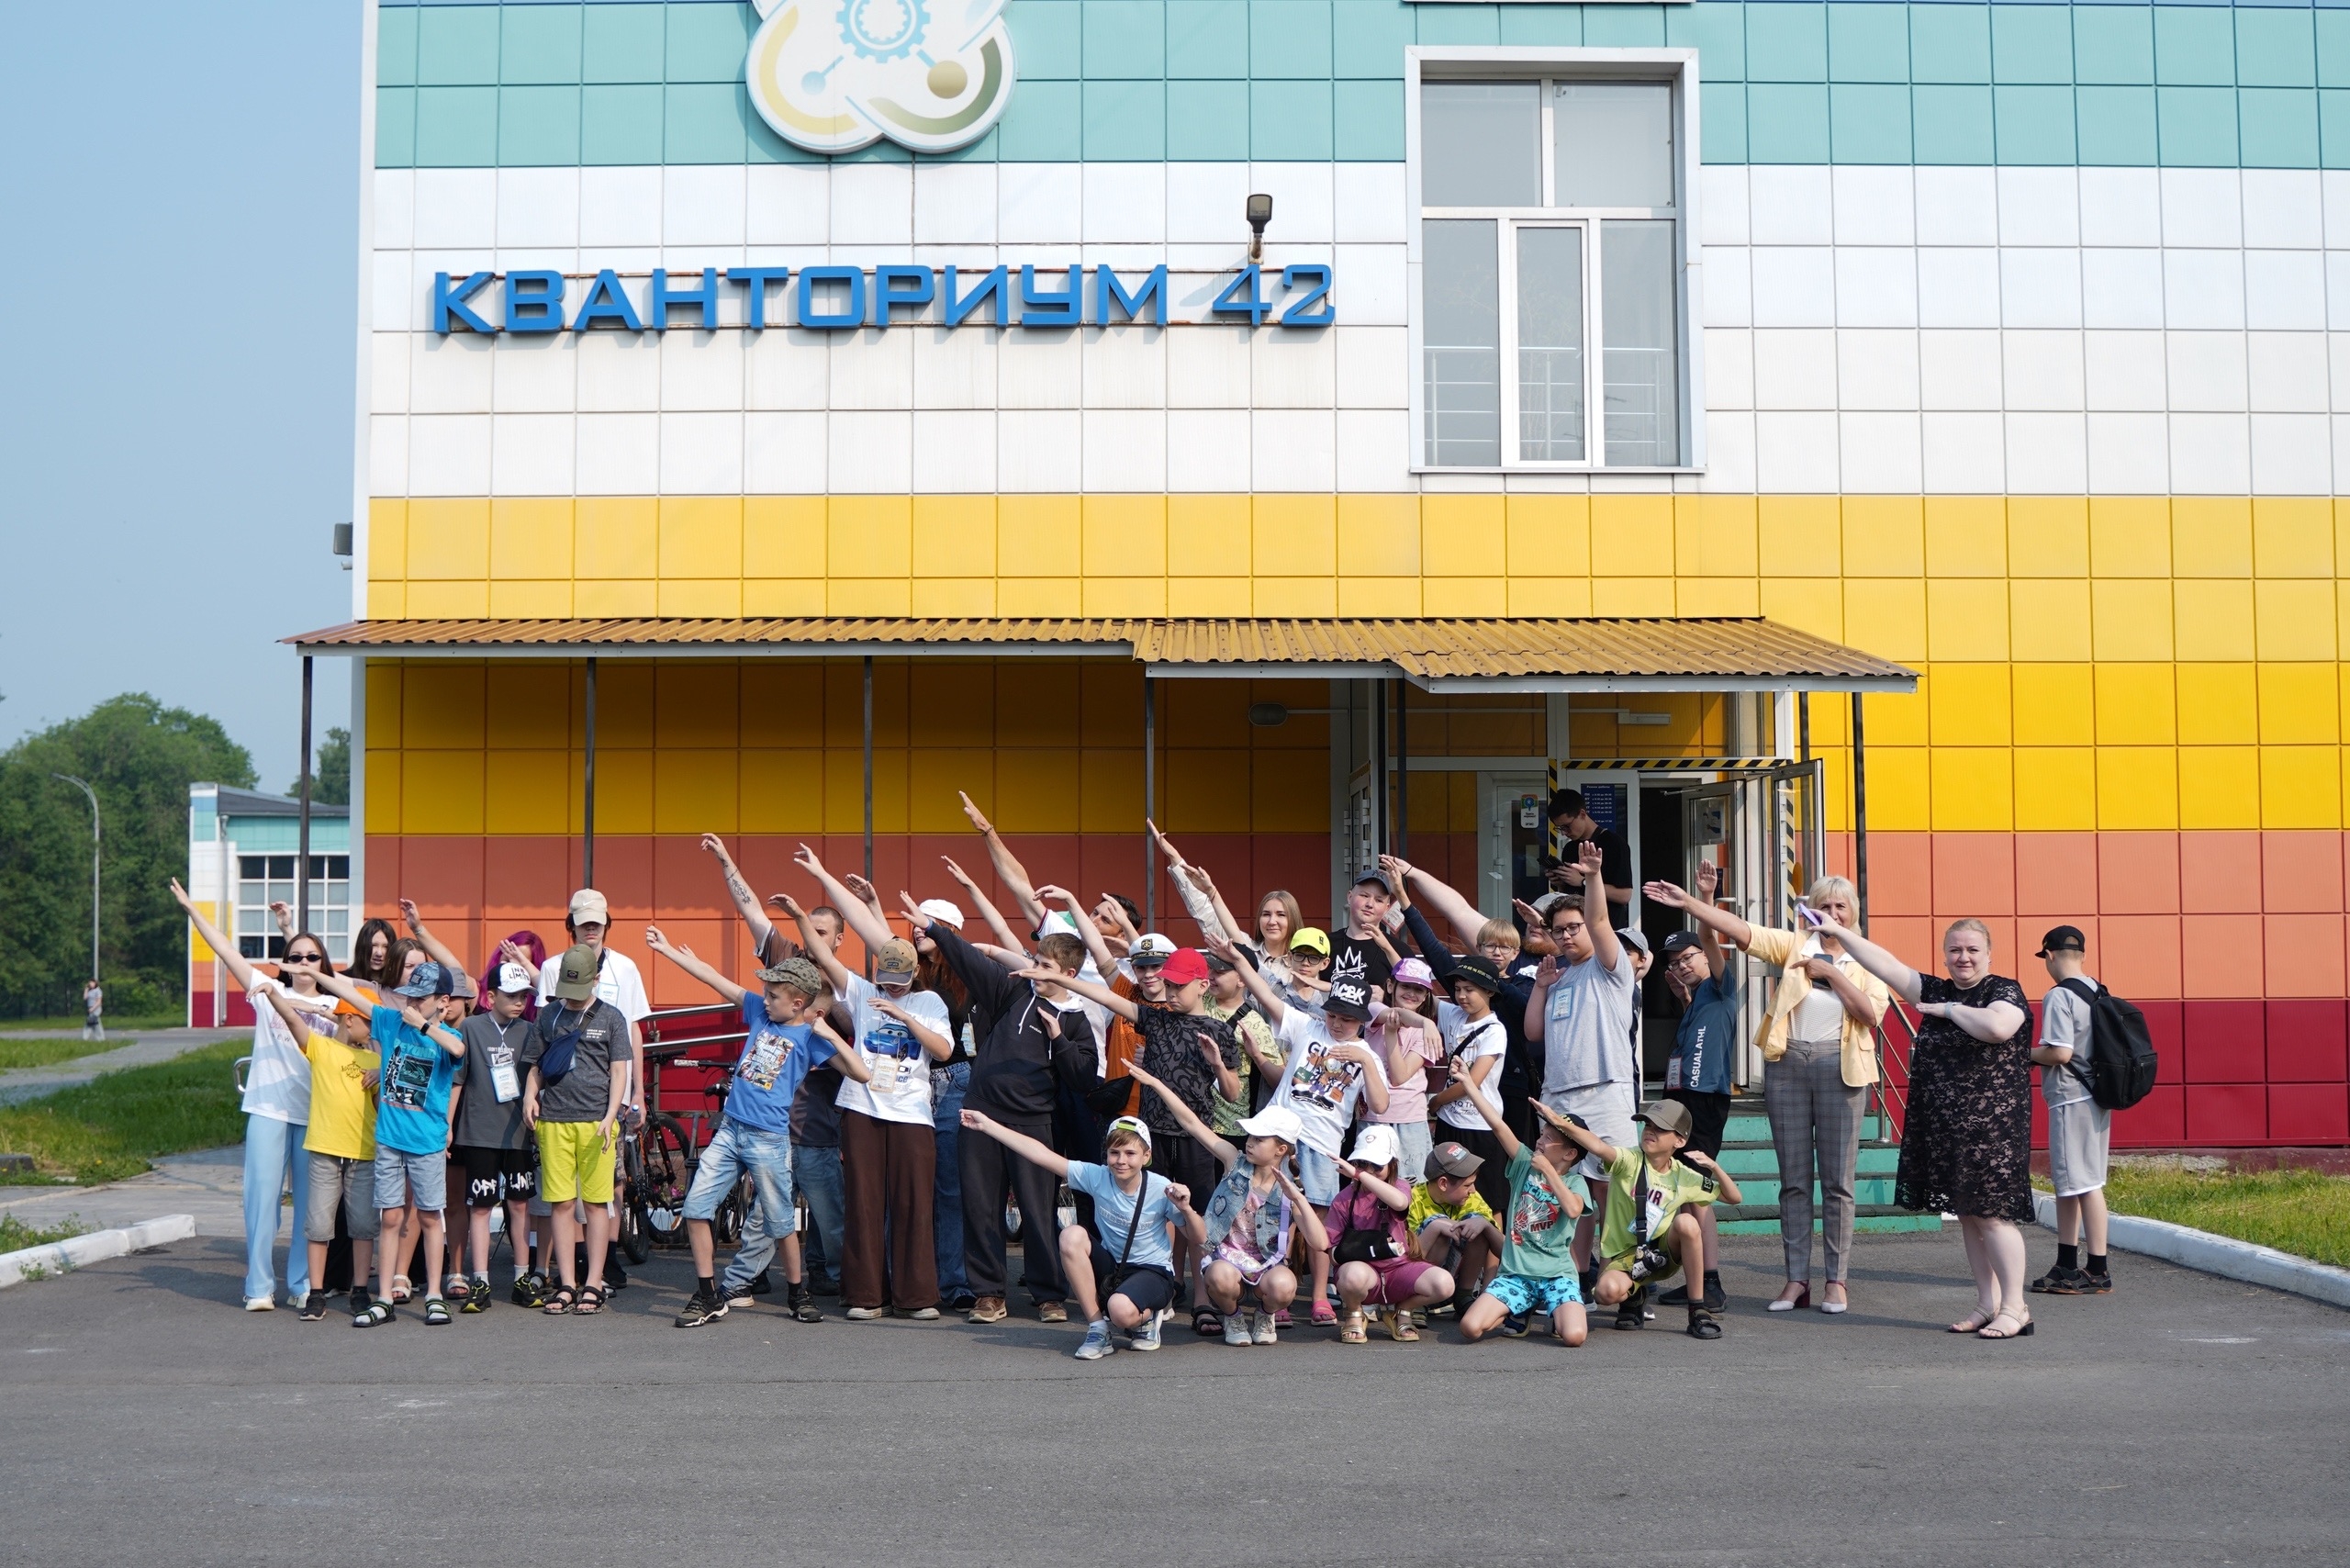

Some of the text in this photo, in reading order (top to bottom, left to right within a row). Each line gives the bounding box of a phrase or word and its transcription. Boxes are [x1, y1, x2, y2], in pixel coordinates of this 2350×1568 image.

[434, 263, 1335, 334] КВАНТОРИУМ 42
[1690, 1049, 1703, 1088] CASUAL
[472, 1178, 498, 1197] OFF
[1530, 1220, 1554, 1232] MVP
